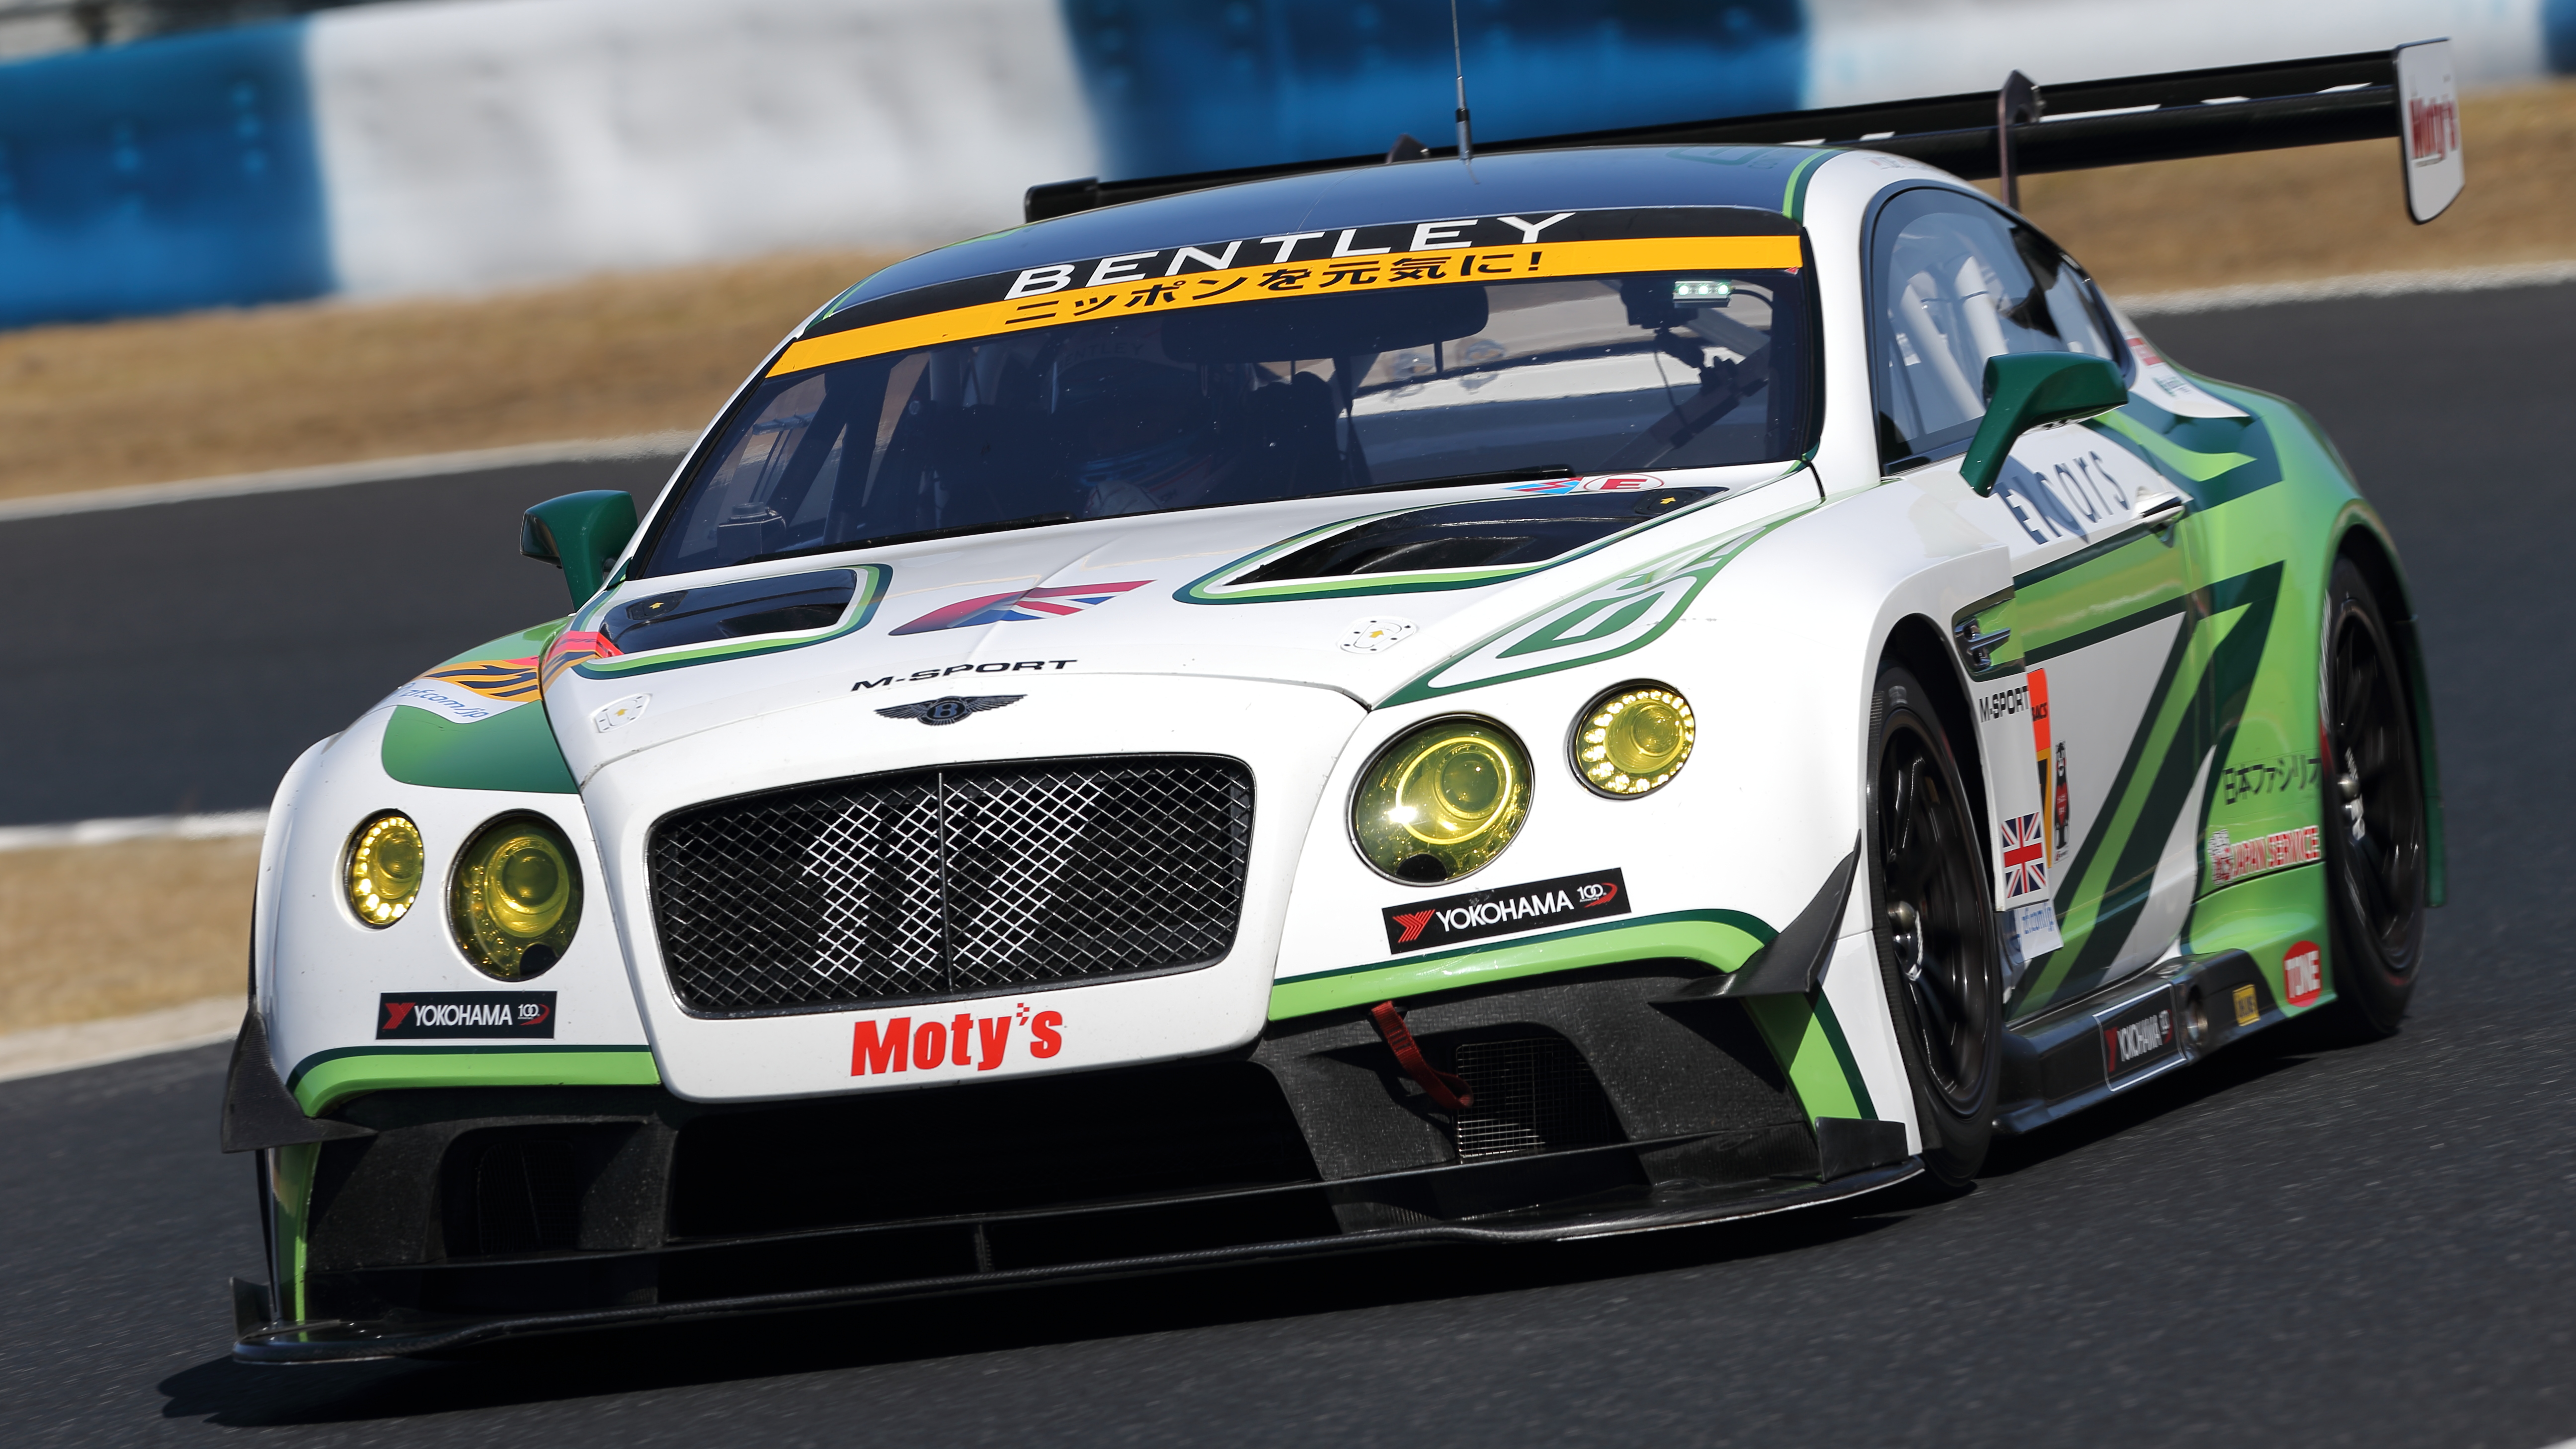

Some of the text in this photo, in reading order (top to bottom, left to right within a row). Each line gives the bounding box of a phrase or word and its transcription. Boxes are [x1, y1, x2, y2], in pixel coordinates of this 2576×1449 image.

[1003, 212, 1576, 300] BENTLEY
[1004, 251, 1543, 325] ニッポンを元気に!
[850, 659, 1078, 692] M-SPORT
[1979, 685, 2029, 724] M-SPORT
[2267, 825, 2321, 869] SERVICE
[1436, 890, 1574, 931] YOKOHAMA
[2284, 950, 2321, 998] TONE
[414, 1004, 513, 1026] YOKOHAMA
[850, 1002, 1063, 1077] Moty's
